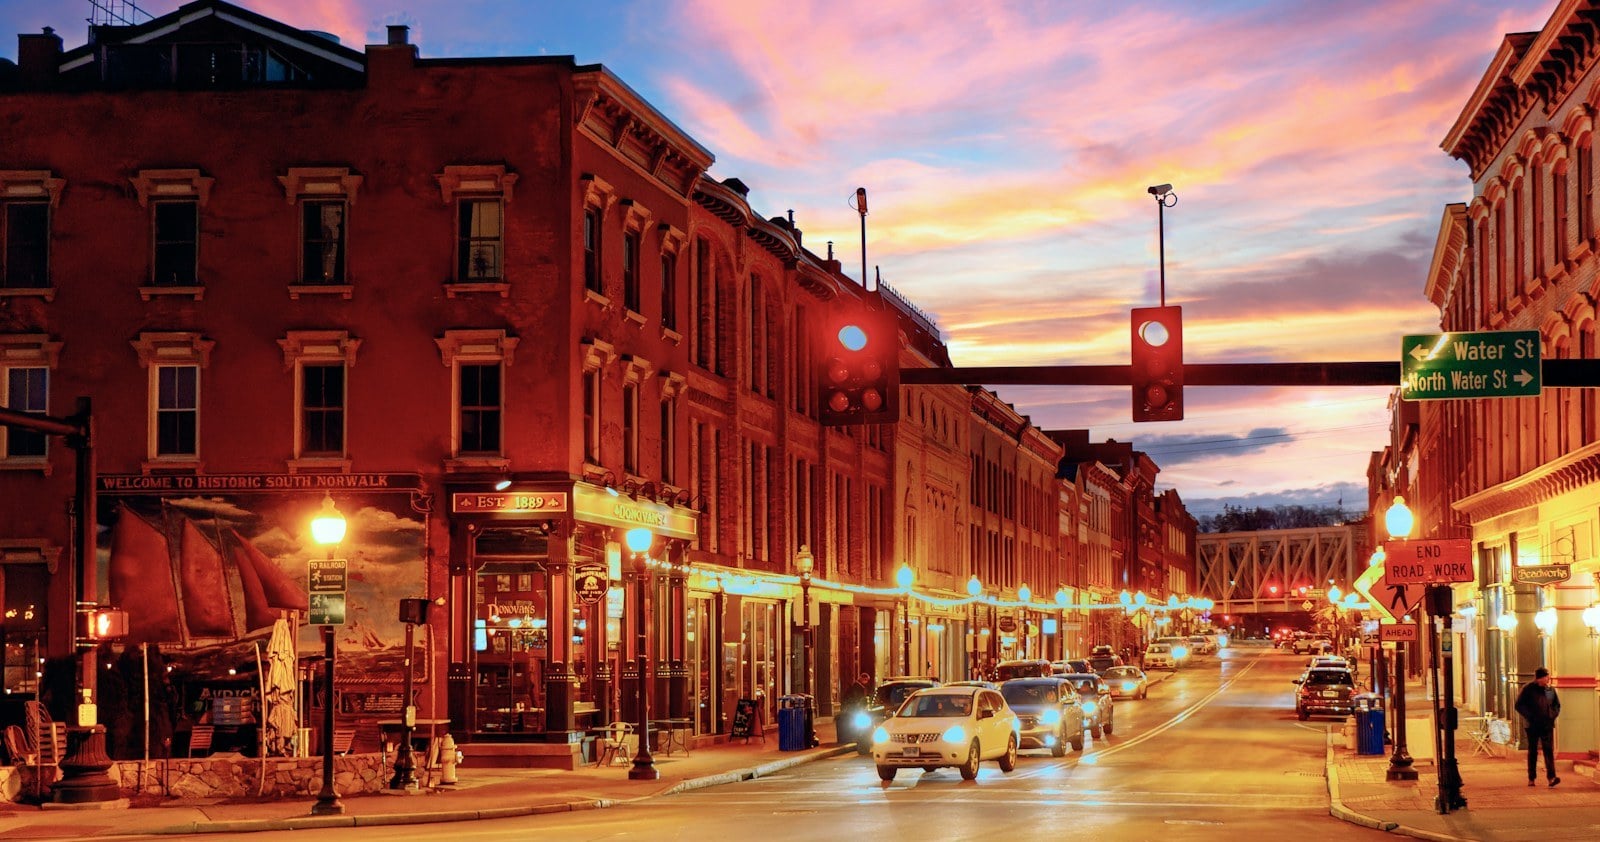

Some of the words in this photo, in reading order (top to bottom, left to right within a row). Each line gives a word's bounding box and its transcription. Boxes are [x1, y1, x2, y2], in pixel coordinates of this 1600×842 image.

[1453, 340, 1505, 361] Water
[1513, 338, 1534, 359] St
[1408, 371, 1446, 392] North
[1451, 369, 1488, 391] Water
[1493, 368, 1508, 390] St
[103, 476, 171, 489] WELCOME
[175, 476, 193, 489] TO
[198, 475, 261, 489] HISTORIC
[265, 475, 311, 488] SOUTH
[316, 475, 388, 487] NORWALK
[477, 496, 506, 508] EST.
[515, 496, 544, 509] 1889
[1416, 545, 1441, 559] END
[310, 562, 318, 570] TO
[319, 561, 346, 569] RAILROAD
[1392, 564, 1424, 578] ROAD
[1433, 562, 1467, 577] WORK
[1363, 634, 1380, 644] 25
[1385, 629, 1413, 637] AHEAD
